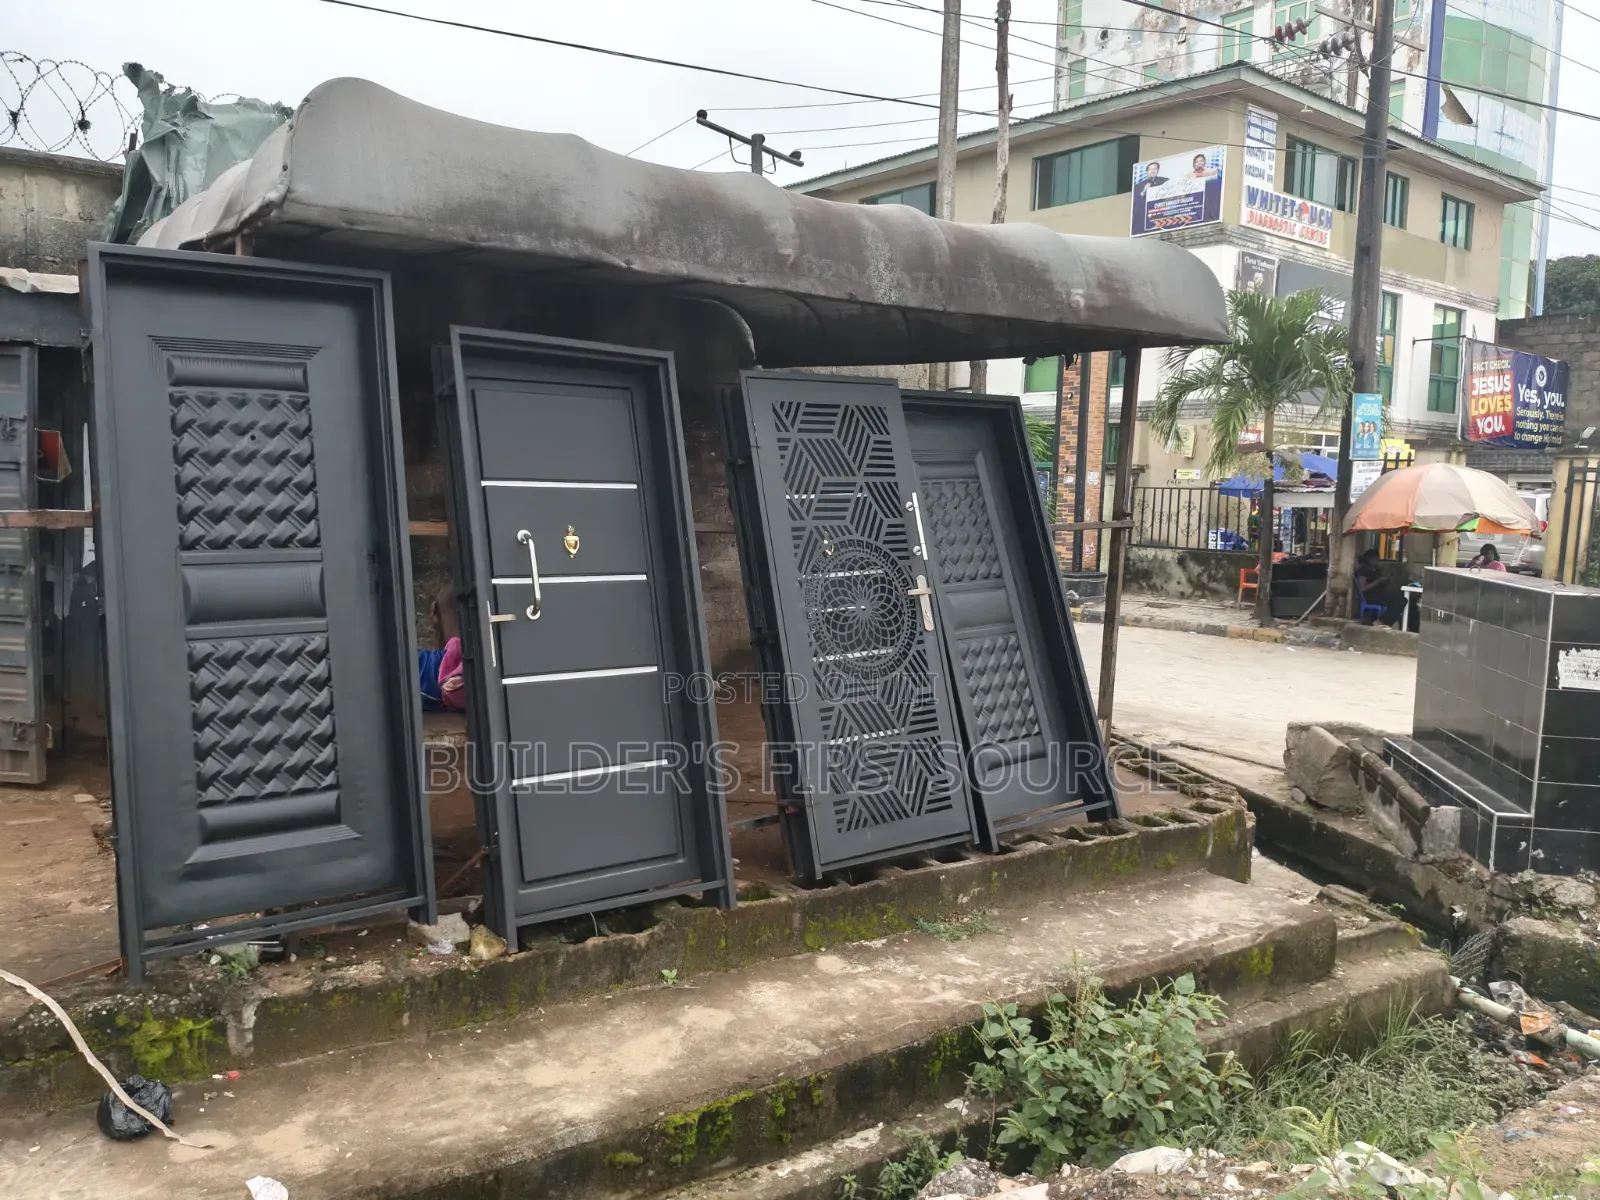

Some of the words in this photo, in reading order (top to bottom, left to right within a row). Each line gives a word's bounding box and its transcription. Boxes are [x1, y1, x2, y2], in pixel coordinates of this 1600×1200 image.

[1247, 210, 1297, 235] DIAGNOSTIC
[1473, 361, 1488, 371] FACT
[1472, 375, 1511, 395] JESUS
[1472, 396, 1511, 415] LOVES
[1518, 384, 1540, 406] Yes,
[1543, 391, 1564, 409] you.
[1477, 416, 1505, 434] YOU.
[1516, 420, 1538, 432] nothing
[1514, 432, 1520, 440] to
